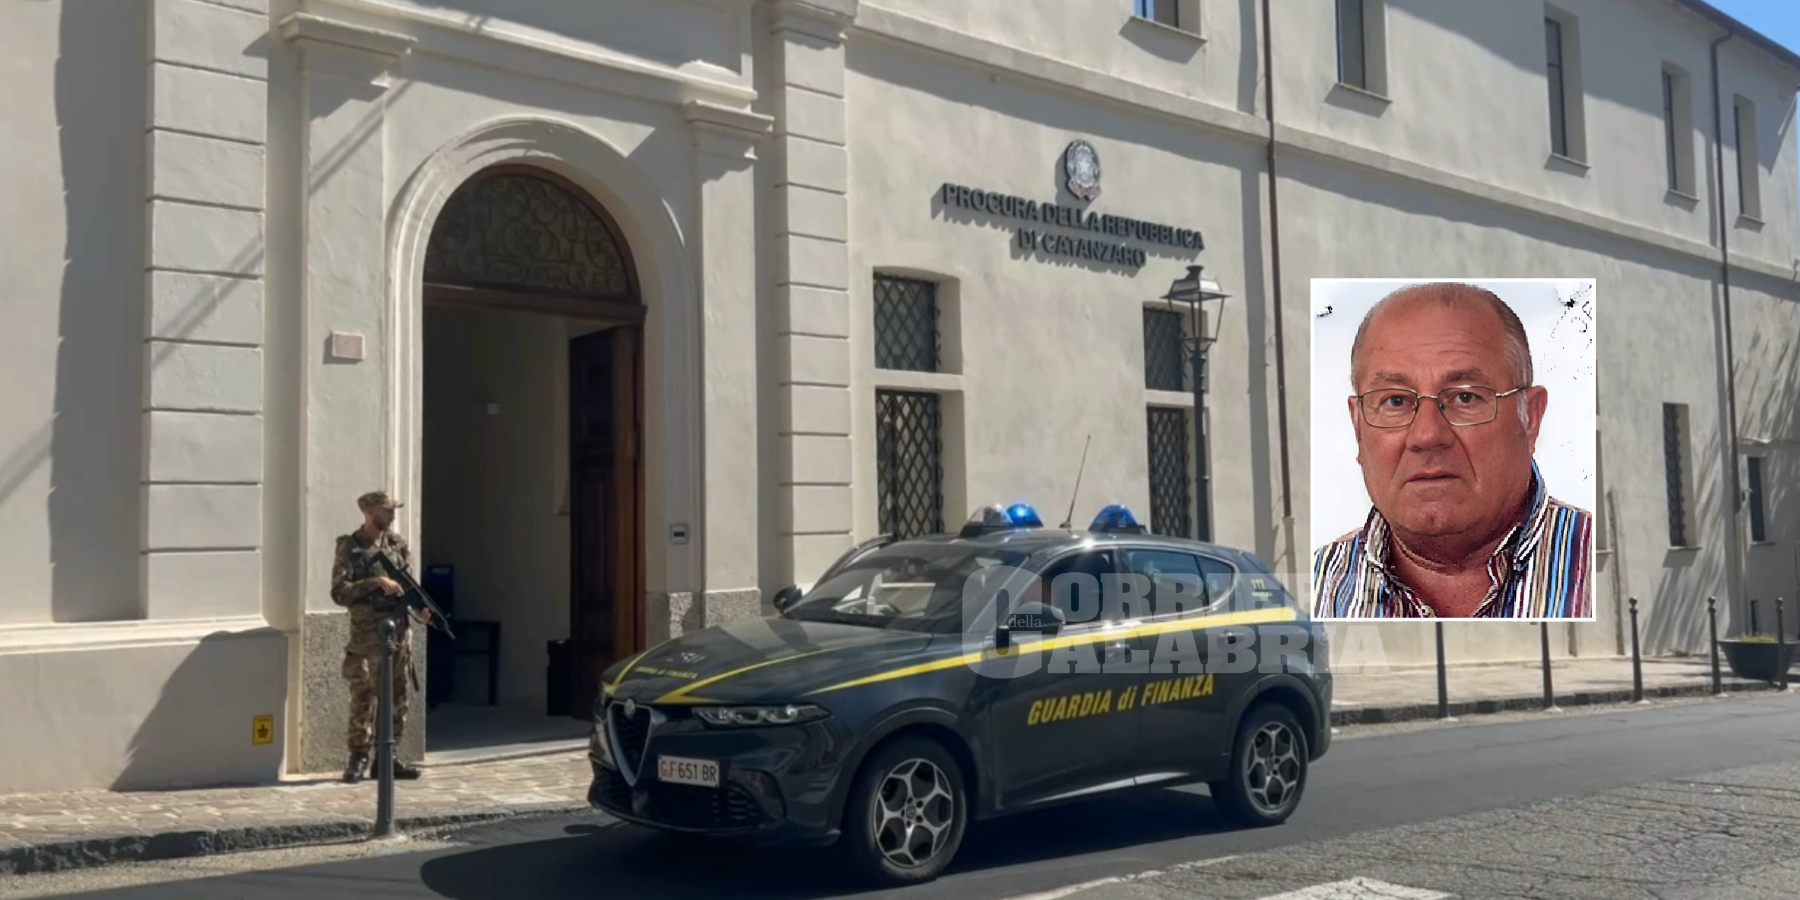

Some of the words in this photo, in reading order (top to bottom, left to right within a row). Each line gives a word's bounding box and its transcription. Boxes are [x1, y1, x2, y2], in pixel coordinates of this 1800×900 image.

[943, 182, 1039, 221] PROCURA
[1042, 202, 1100, 232] DELLA
[1101, 213, 1205, 250] REPUBBLICA
[1018, 227, 1037, 251] DI
[1041, 232, 1147, 268] CATANZARO
[1027, 689, 1113, 726] GUARDIA
[1116, 685, 1138, 711] di
[1141, 673, 1214, 707] FINANZA
[678, 761, 698, 780] 651
[702, 764, 717, 783] BR
